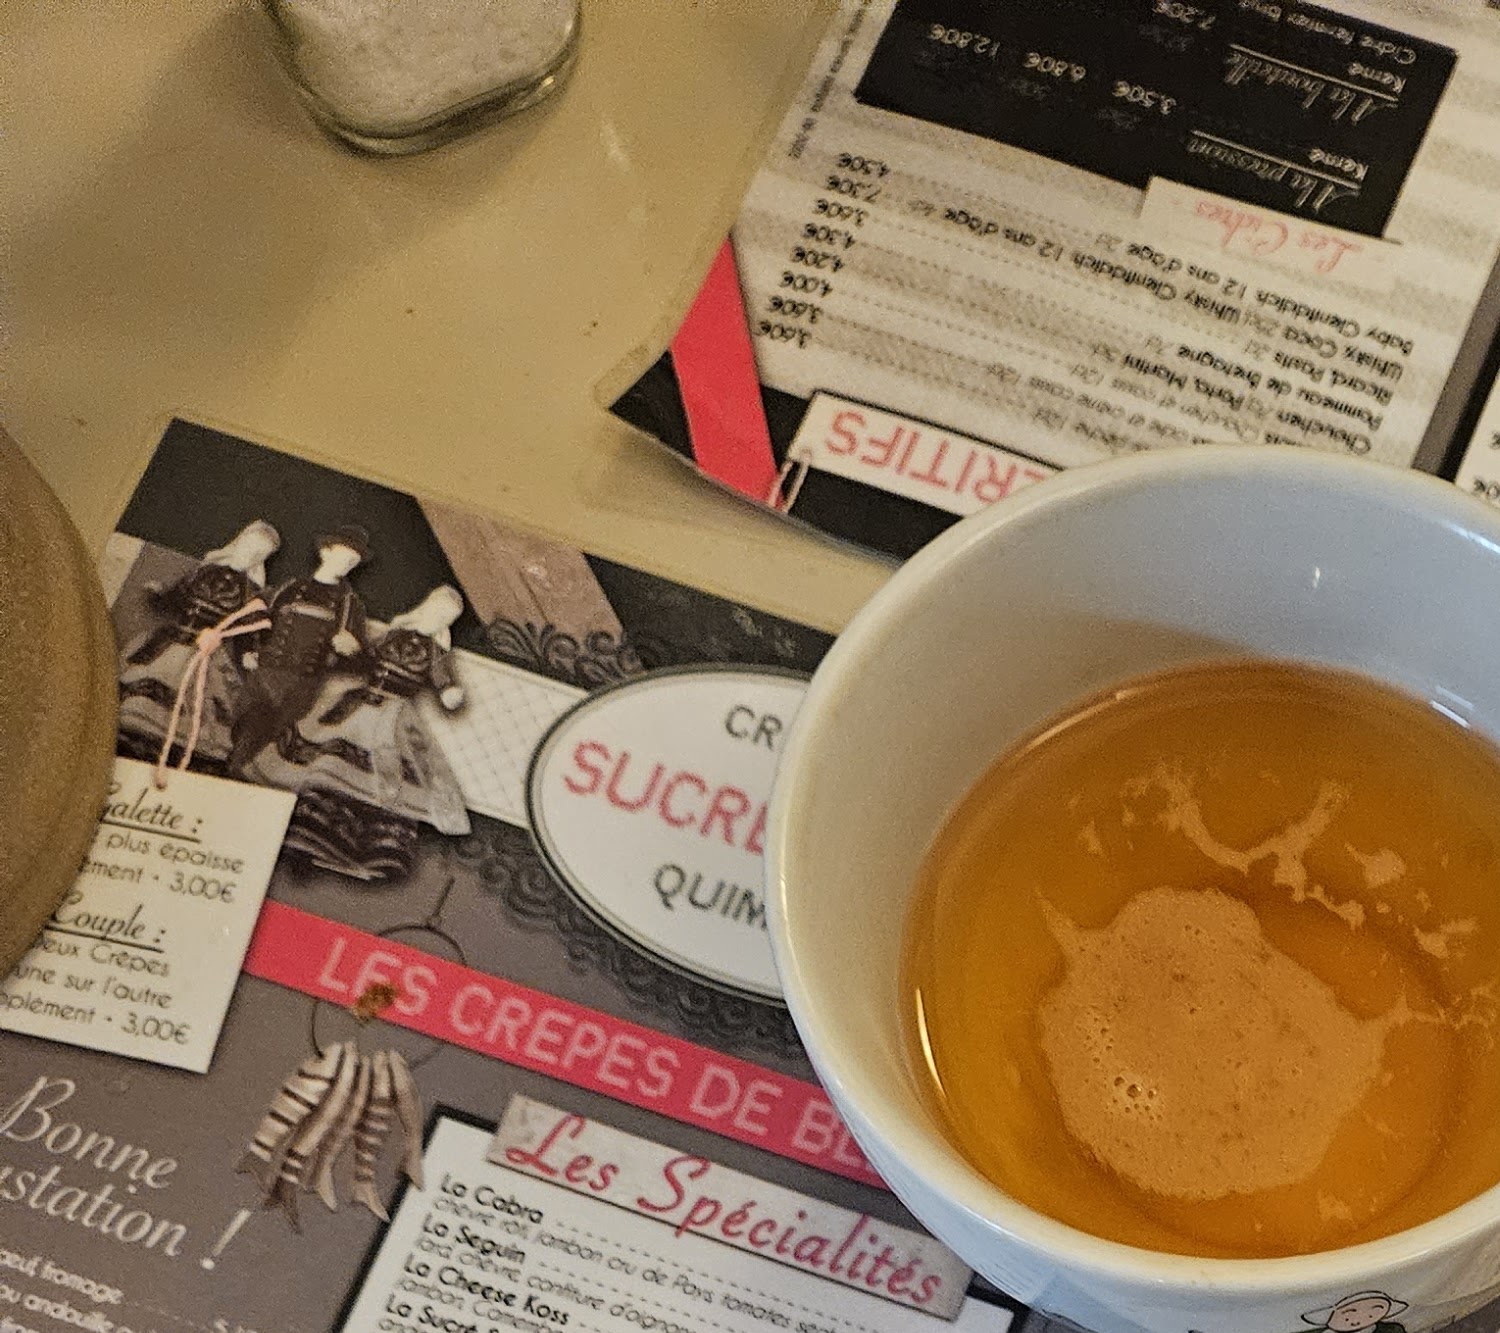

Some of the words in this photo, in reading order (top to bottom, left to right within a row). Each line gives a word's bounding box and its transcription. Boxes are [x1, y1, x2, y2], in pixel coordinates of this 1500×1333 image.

[170, 872, 234, 902] 3,00€
[654, 863, 768, 930] QUIM
[64, 973, 95, 997] sur
[123, 1012, 188, 1043] 3,00€
[321, 941, 433, 1012] LES
[453, 987, 682, 1100] CREPES
[689, 1061, 780, 1134] DE
[0, 1078, 179, 1187] Bonne
[440, 1179, 469, 1197] La
[475, 1186, 542, 1223] Cabra
[505, 1115, 620, 1190] Les
[637, 1155, 937, 1313] Spécialités
[423, 1218, 452, 1237] La
[455, 1225, 524, 1259] Seguin
[385, 1299, 412, 1317] La
[404, 1258, 431, 1277] La
[439, 1266, 517, 1306] Cheese
[523, 1295, 570, 1325] Koss
